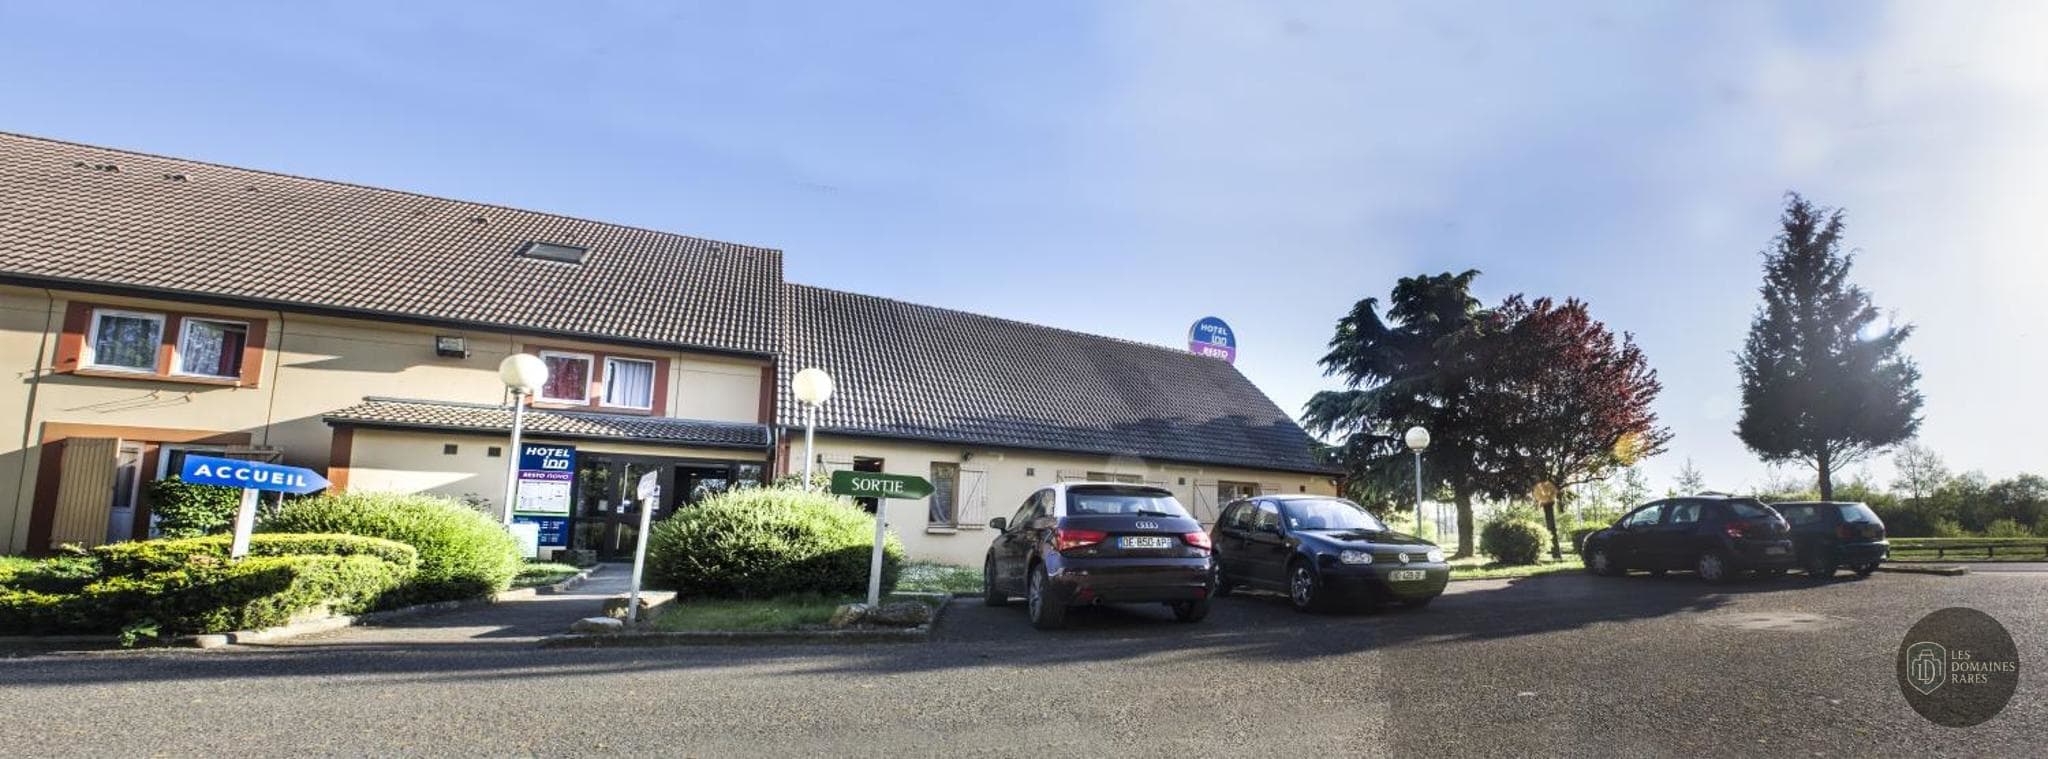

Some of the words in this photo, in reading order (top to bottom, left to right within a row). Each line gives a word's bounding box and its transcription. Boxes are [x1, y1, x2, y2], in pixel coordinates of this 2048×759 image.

[1201, 323, 1228, 335] HOTEL
[1203, 346, 1228, 359] RESTO
[526, 447, 570, 457] HOTEL
[194, 464, 307, 487] ACCUEIL
[523, 471, 545, 479] RESTO
[851, 477, 904, 493] SORTIE
